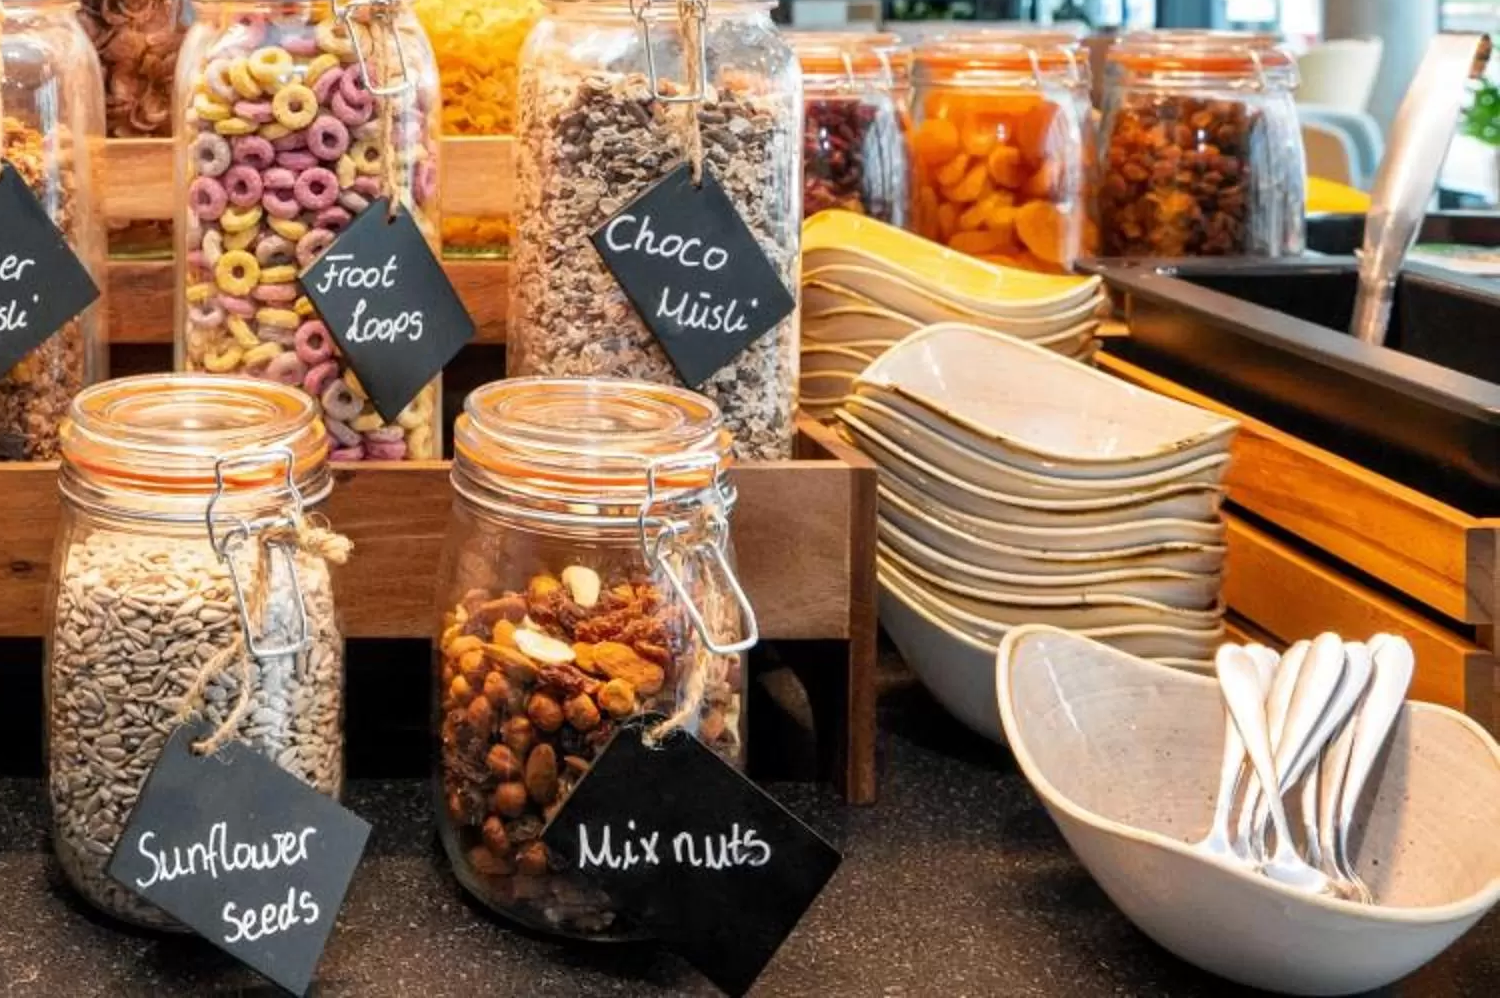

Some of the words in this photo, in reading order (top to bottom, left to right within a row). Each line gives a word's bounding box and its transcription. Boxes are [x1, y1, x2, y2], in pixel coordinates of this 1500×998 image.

[604, 214, 730, 272] Choco
[315, 253, 399, 295] Froot
[344, 296, 425, 344] Loops
[134, 820, 318, 889] Sunflower
[577, 818, 661, 872] Mix
[672, 821, 773, 871] nuts
[220, 885, 321, 944] Seeds
